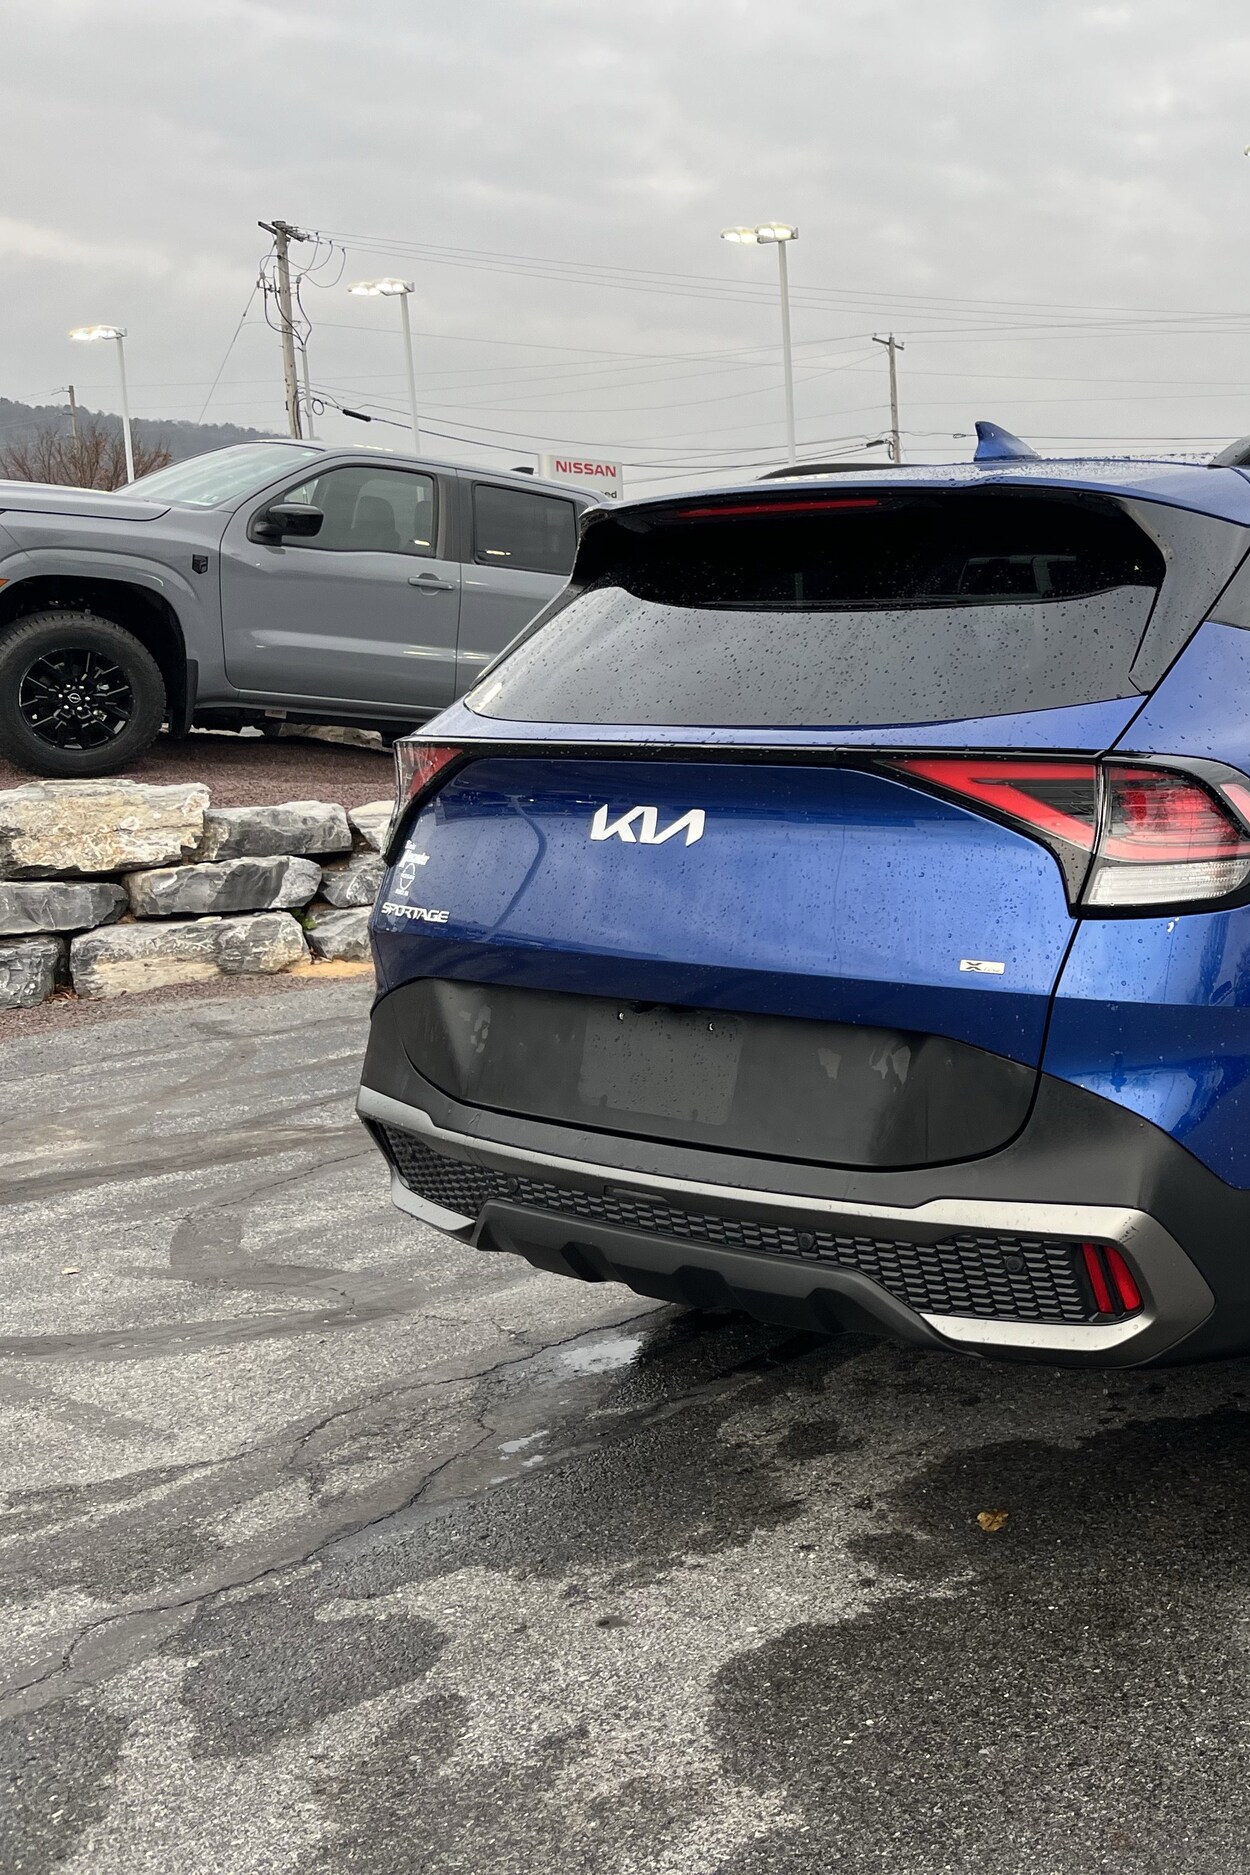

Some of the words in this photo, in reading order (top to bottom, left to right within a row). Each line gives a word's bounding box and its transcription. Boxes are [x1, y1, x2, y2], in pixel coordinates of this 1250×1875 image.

[555, 460, 617, 478] NISSAN
[590, 803, 706, 847] KIA
[380, 902, 450, 923] SPORTAGE
